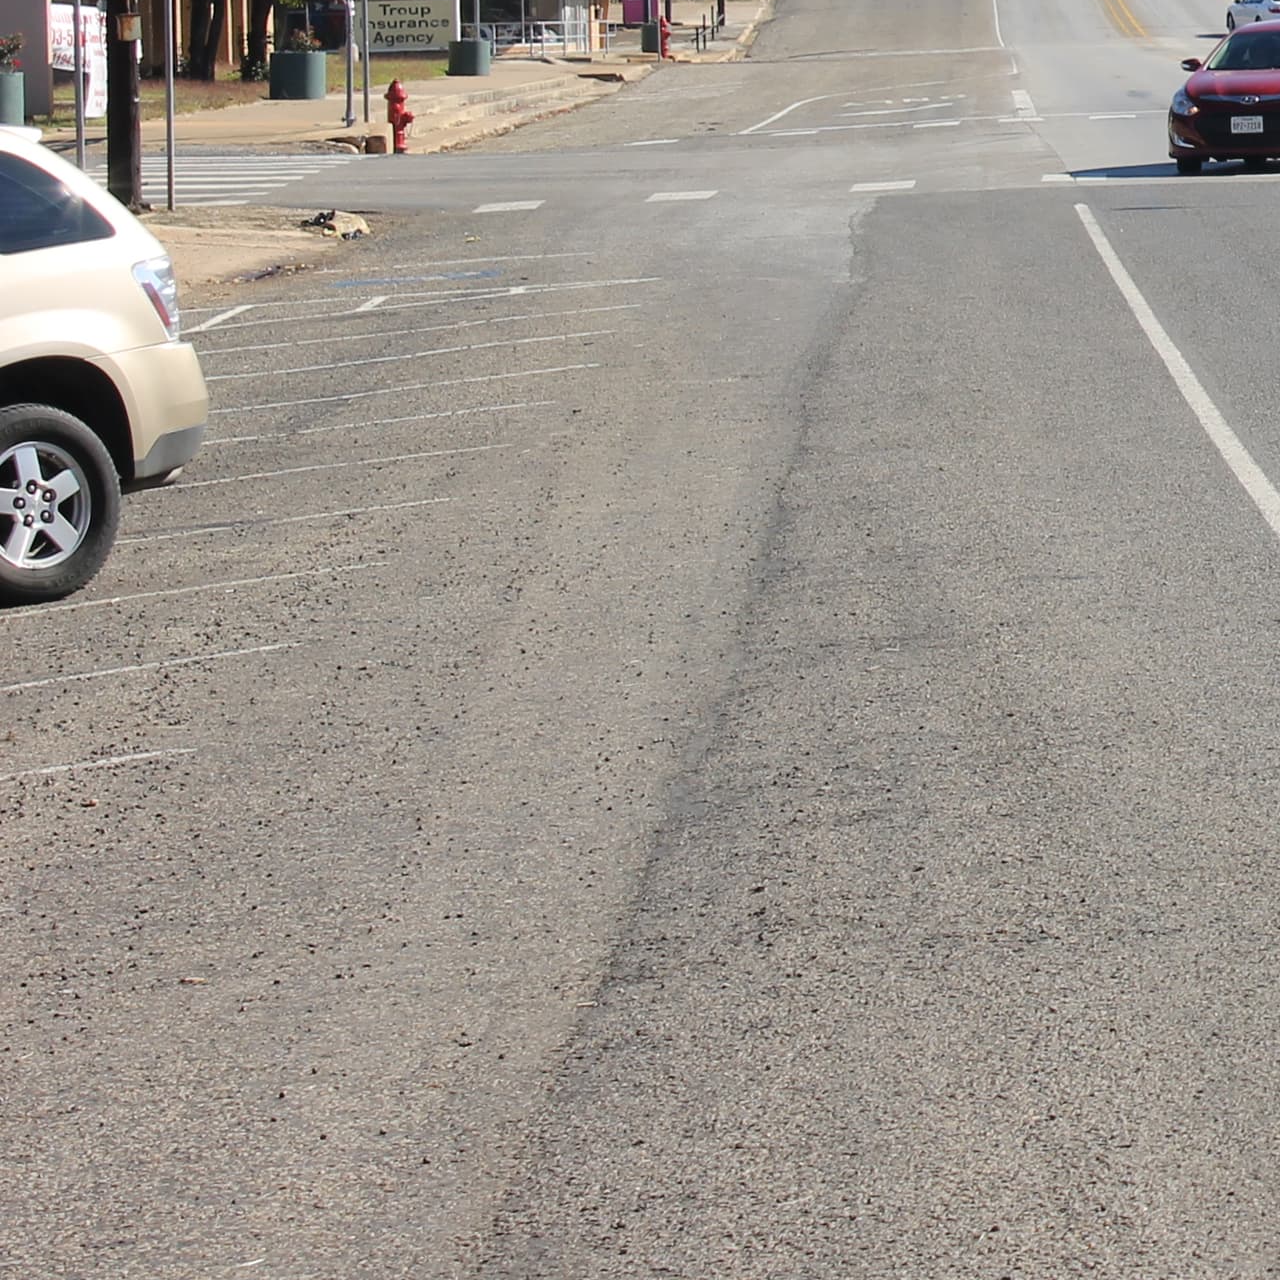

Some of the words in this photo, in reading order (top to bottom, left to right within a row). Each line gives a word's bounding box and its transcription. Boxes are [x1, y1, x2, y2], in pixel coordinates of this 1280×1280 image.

[378, 4, 431, 18] Troup
[361, 19, 449, 30] nsurance
[373, 31, 434, 47] Agency
